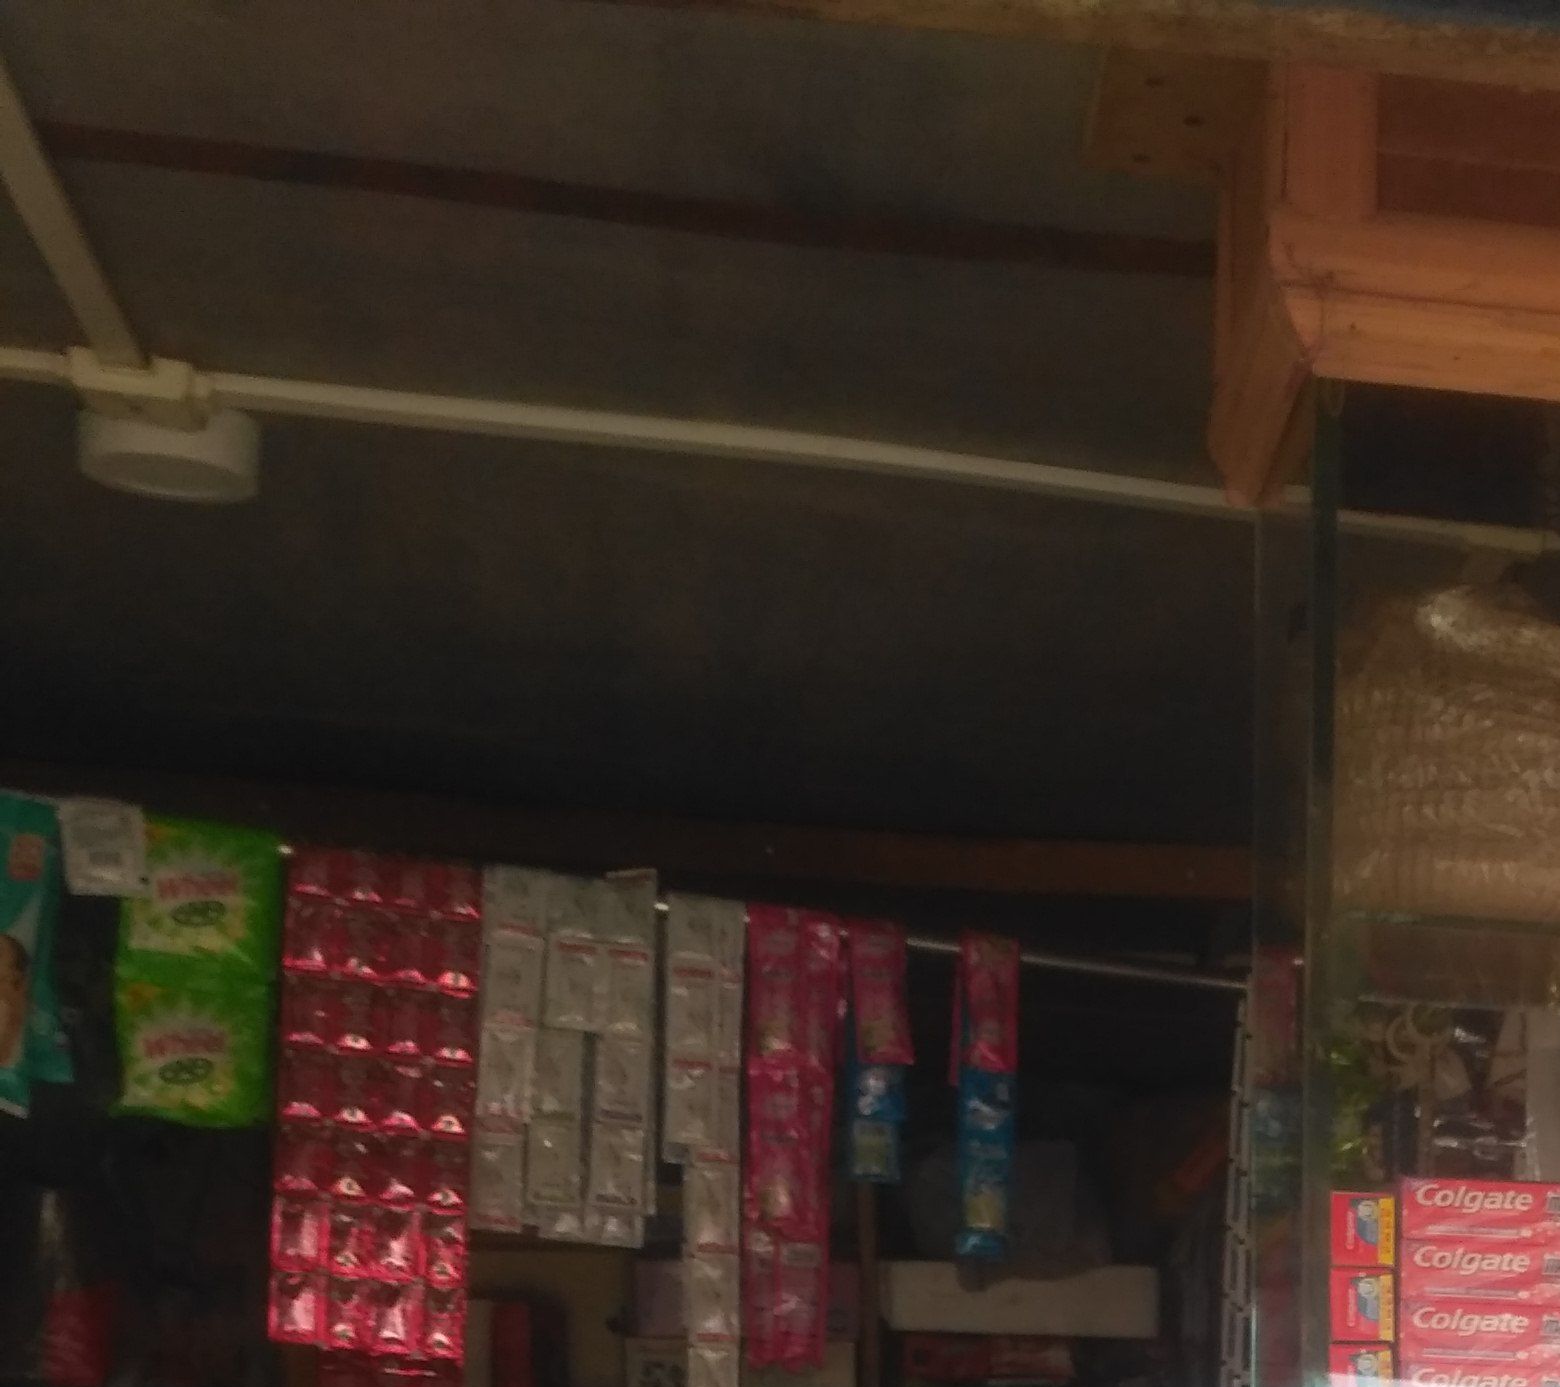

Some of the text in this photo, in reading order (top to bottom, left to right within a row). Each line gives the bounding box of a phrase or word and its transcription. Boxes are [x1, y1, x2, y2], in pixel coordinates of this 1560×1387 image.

[1415, 1182, 1534, 1212] Colgate
[1413, 1246, 1531, 1275] Colgate
[1412, 1307, 1531, 1337] Colgate
